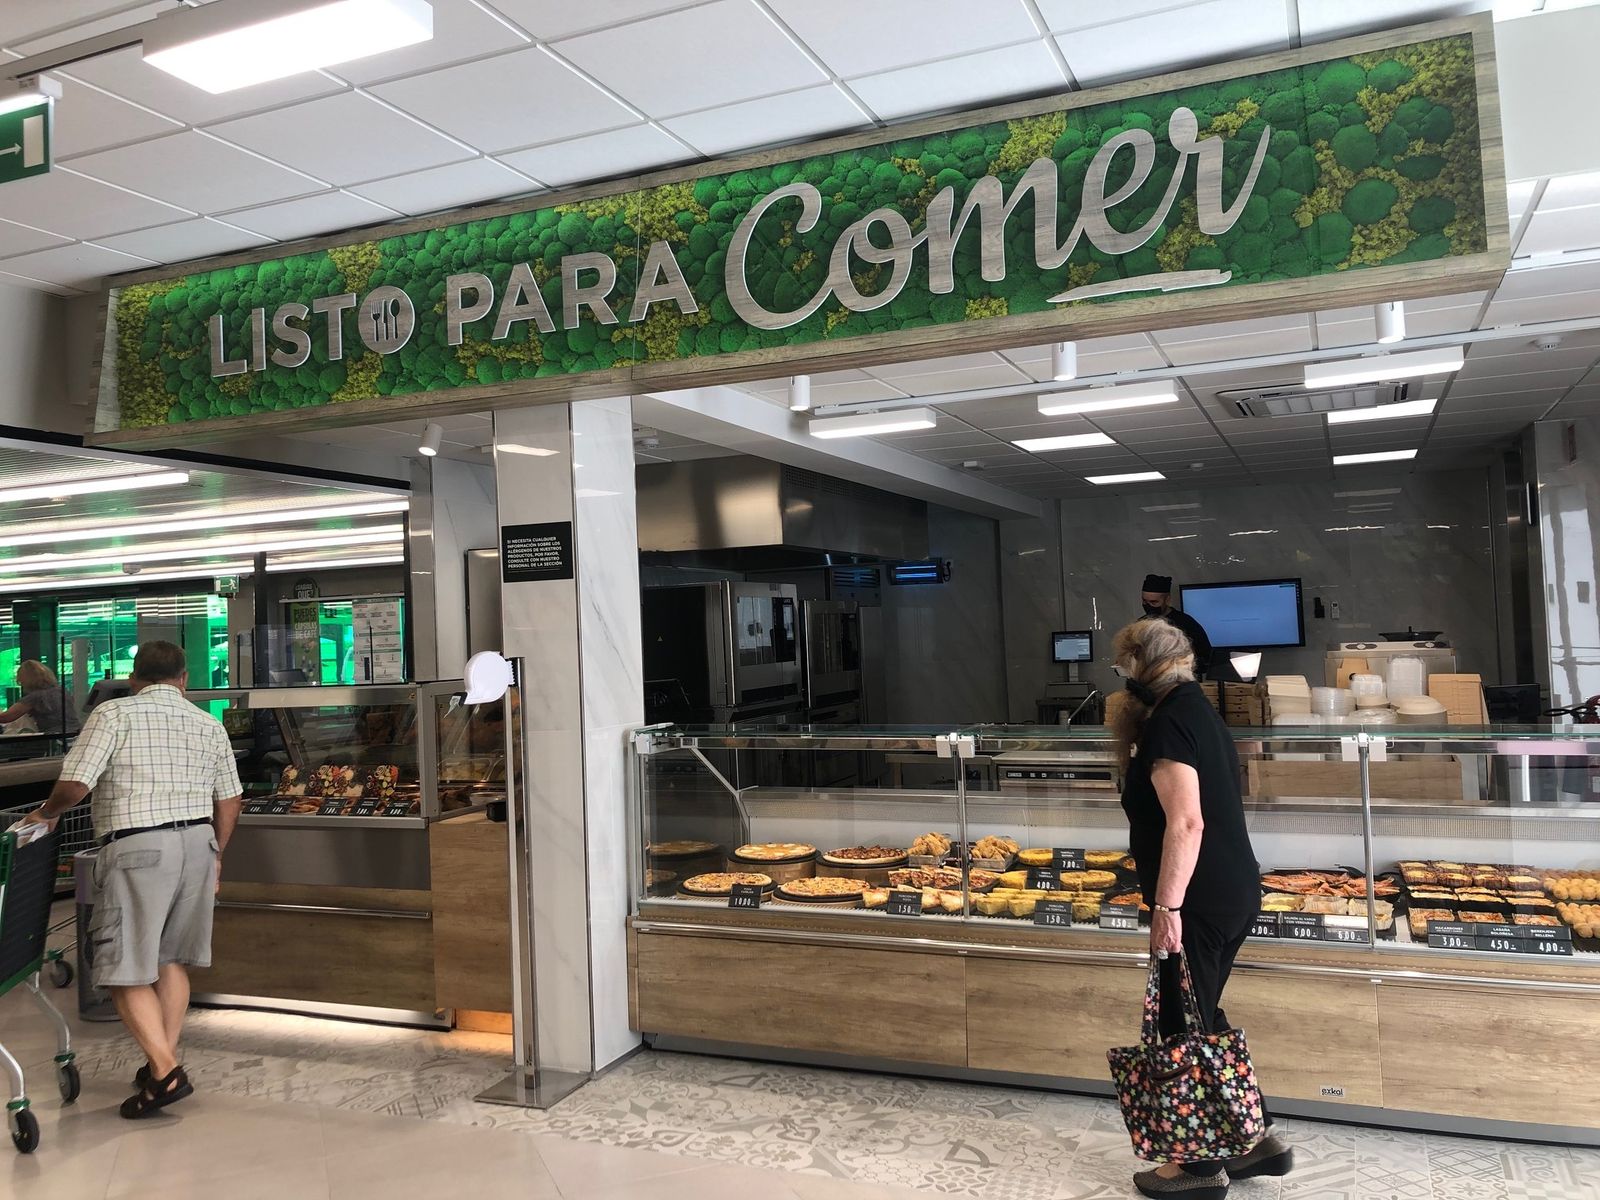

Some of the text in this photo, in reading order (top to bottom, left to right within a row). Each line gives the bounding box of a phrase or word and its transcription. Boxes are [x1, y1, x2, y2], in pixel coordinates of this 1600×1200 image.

[209, 106, 1270, 378] LISTO PARA Comer
